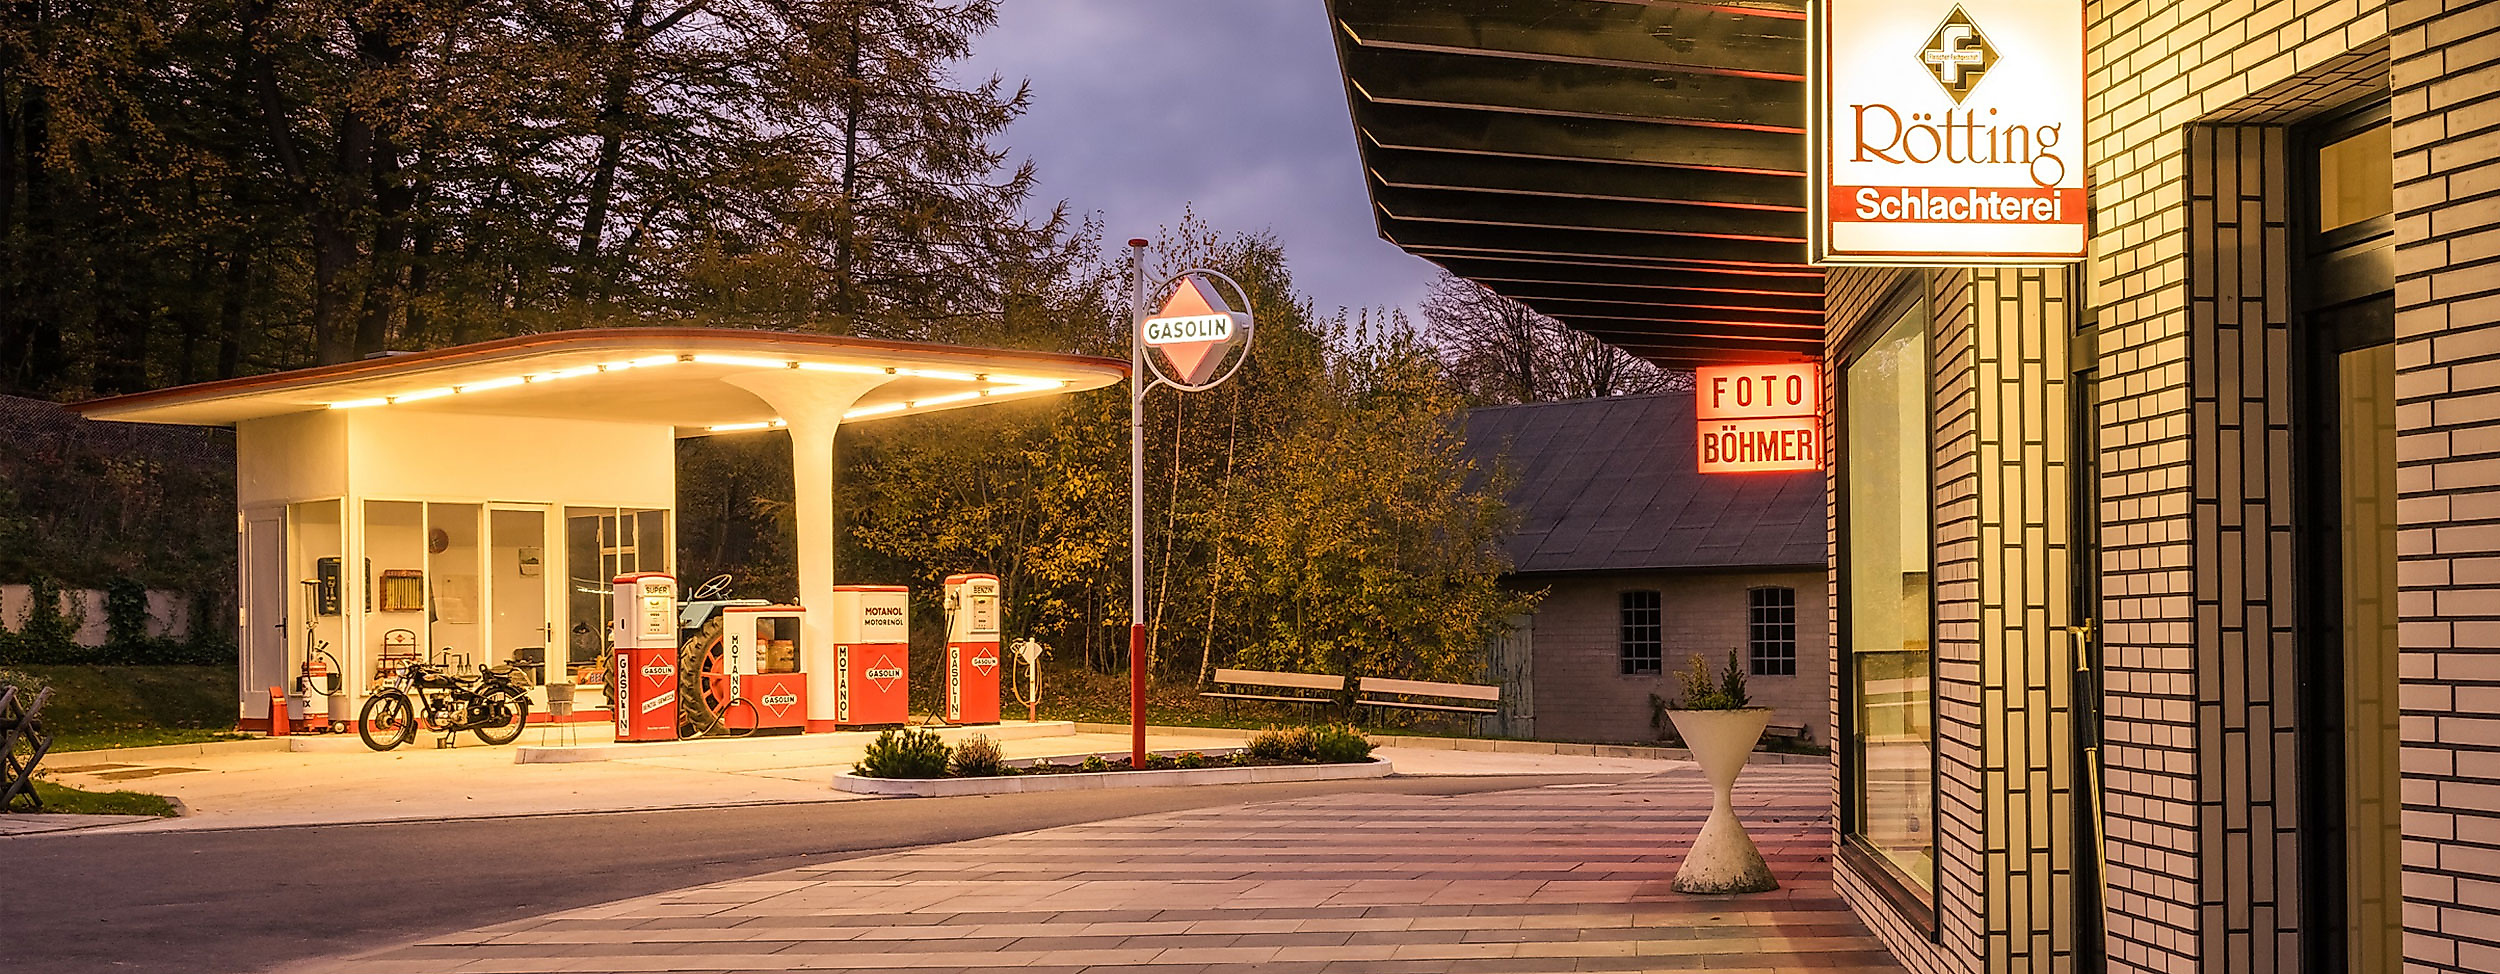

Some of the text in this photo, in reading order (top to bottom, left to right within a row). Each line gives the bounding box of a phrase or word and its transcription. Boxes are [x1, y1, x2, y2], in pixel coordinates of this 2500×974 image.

[1850, 103, 2065, 188] Rötting
[1856, 187, 2061, 221] Schlachterei
[1148, 318, 1226, 340] GASOLIN
[1713, 375, 1802, 408] FOTO
[1704, 425, 1813, 464] BÖHMER
[645, 586, 668, 594] SUPER
[864, 617, 904, 626] MOTORENÖL
[865, 607, 903, 616] MOTANOL
[839, 647, 847, 720] MOTANOL
[868, 669, 900, 677] GASOLIN
[951, 650, 959, 713] GASOLIN
[619, 658, 628, 728] GASOLIN
[764, 696, 795, 704] GASOLIN
